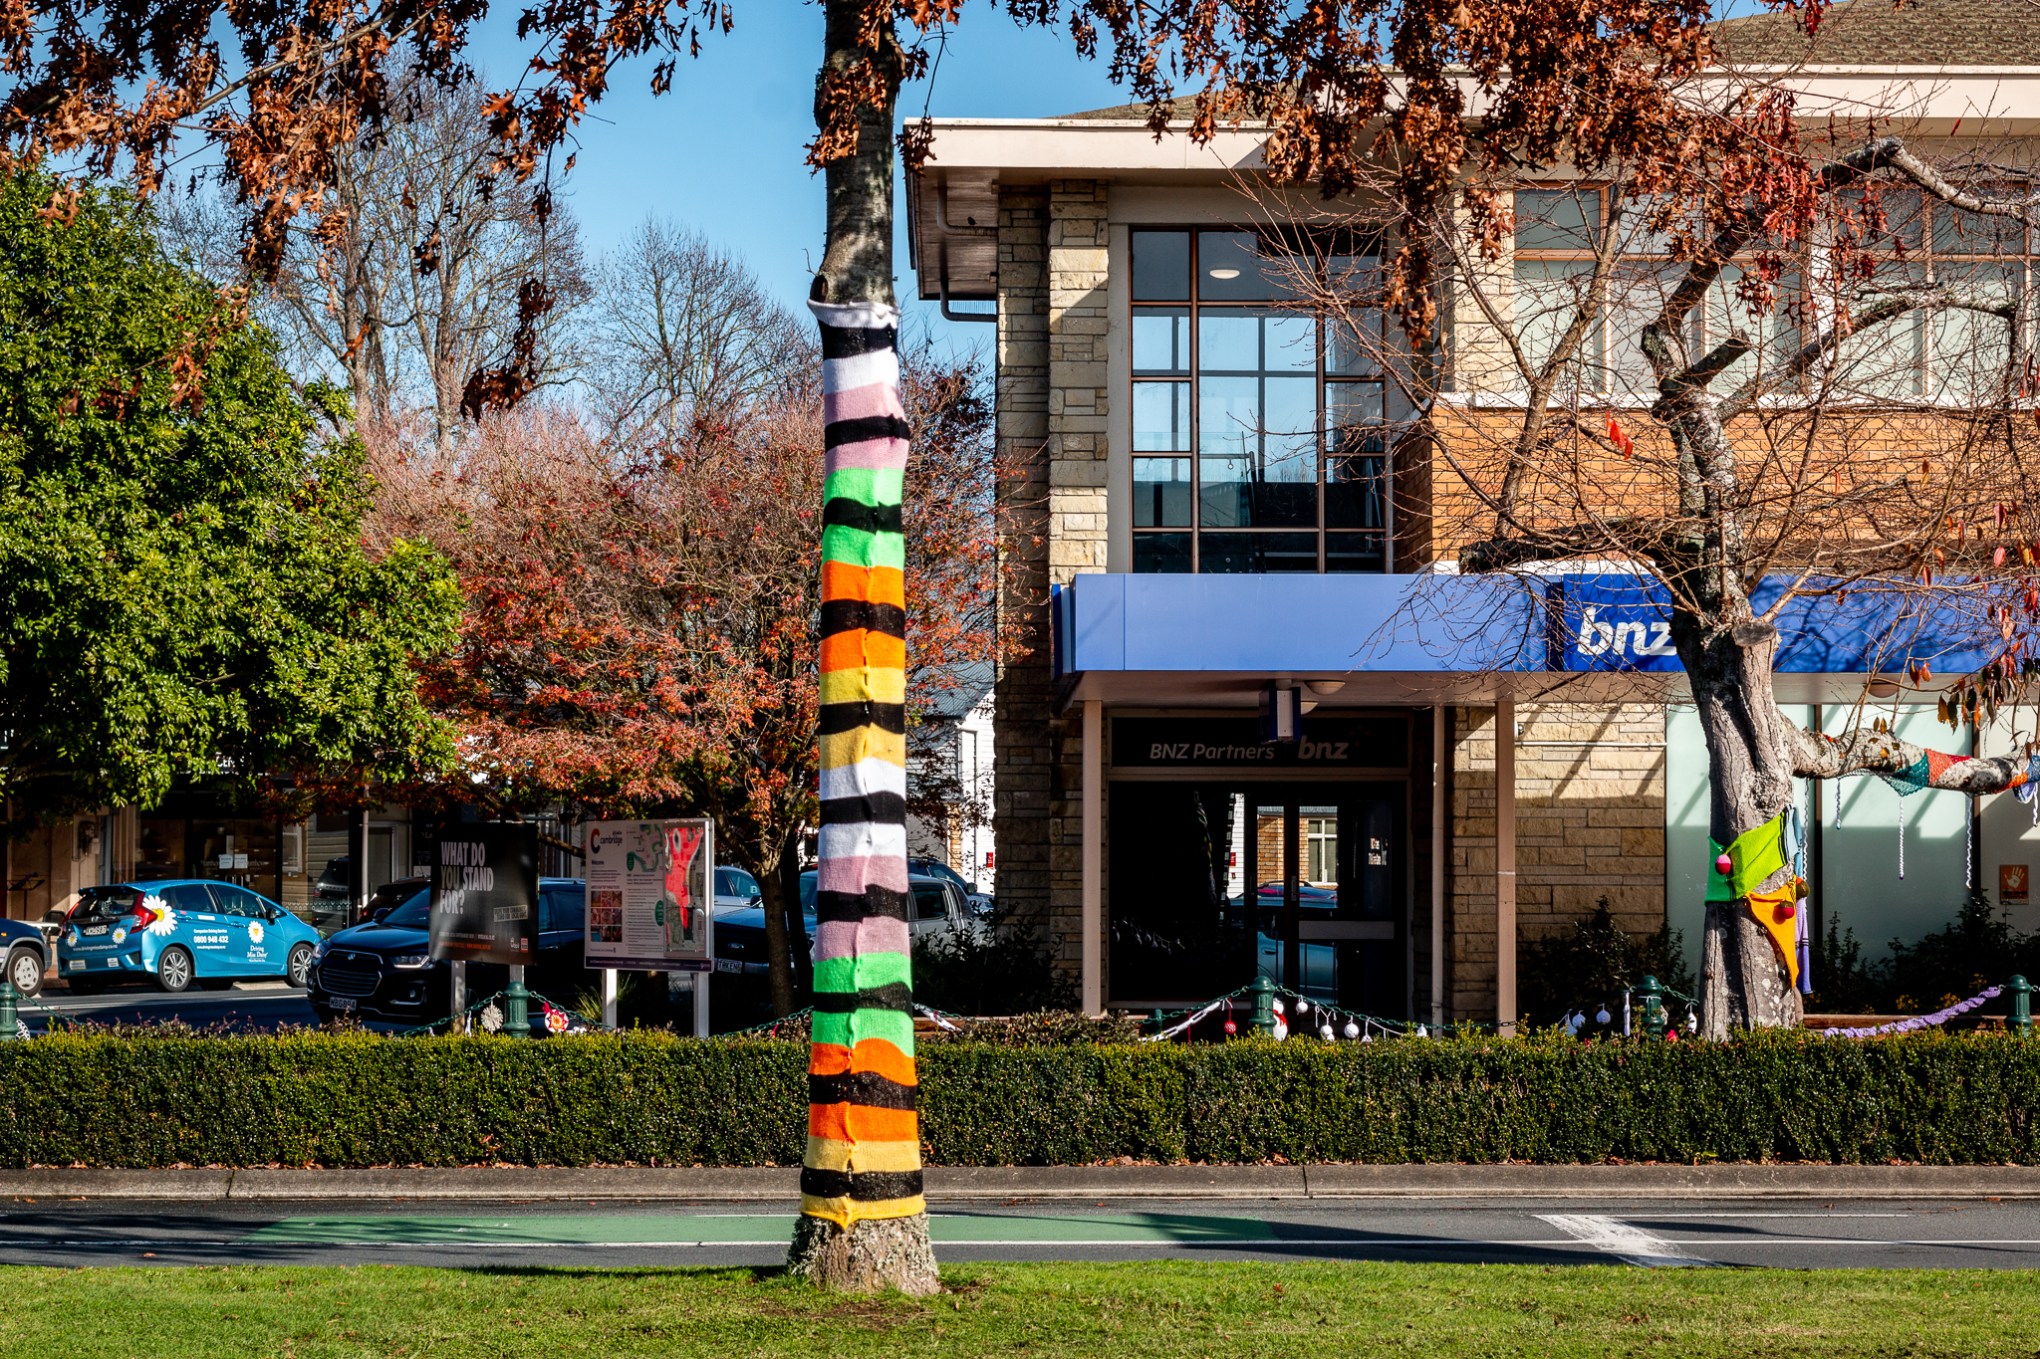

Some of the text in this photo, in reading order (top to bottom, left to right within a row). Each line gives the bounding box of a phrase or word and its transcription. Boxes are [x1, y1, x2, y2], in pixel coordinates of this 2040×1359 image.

[1577, 605, 1678, 656] bnz
[1150, 743, 1274, 759] BNZ Partners
[1297, 735, 1349, 759] bnz
[440, 841, 486, 866] WHAT DO
[440, 865, 494, 891] YOU STAND
[439, 889, 465, 915] FOR?
[193, 935, 229, 944] 0800 948 432
